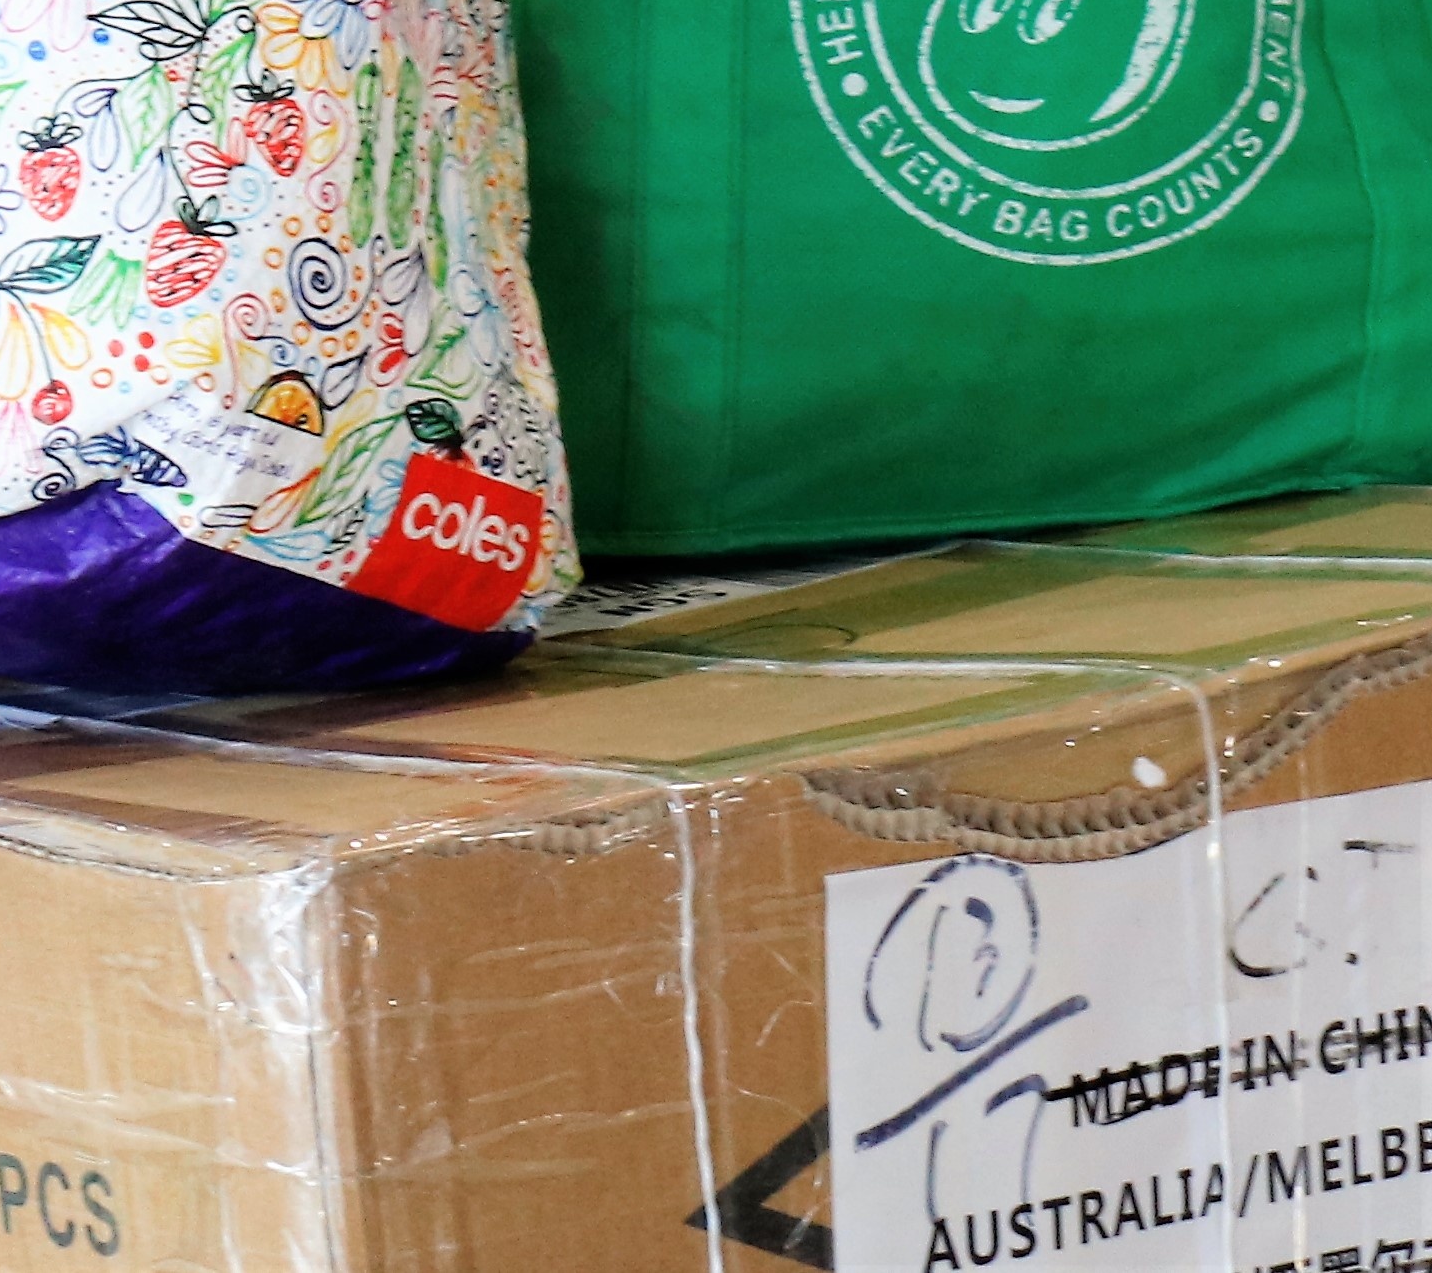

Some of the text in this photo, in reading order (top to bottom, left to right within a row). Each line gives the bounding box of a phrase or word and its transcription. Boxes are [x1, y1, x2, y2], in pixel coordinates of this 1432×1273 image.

[857, 105, 1264, 242] EVERY BAG COUNTS
[403, 492, 530, 572] coles
